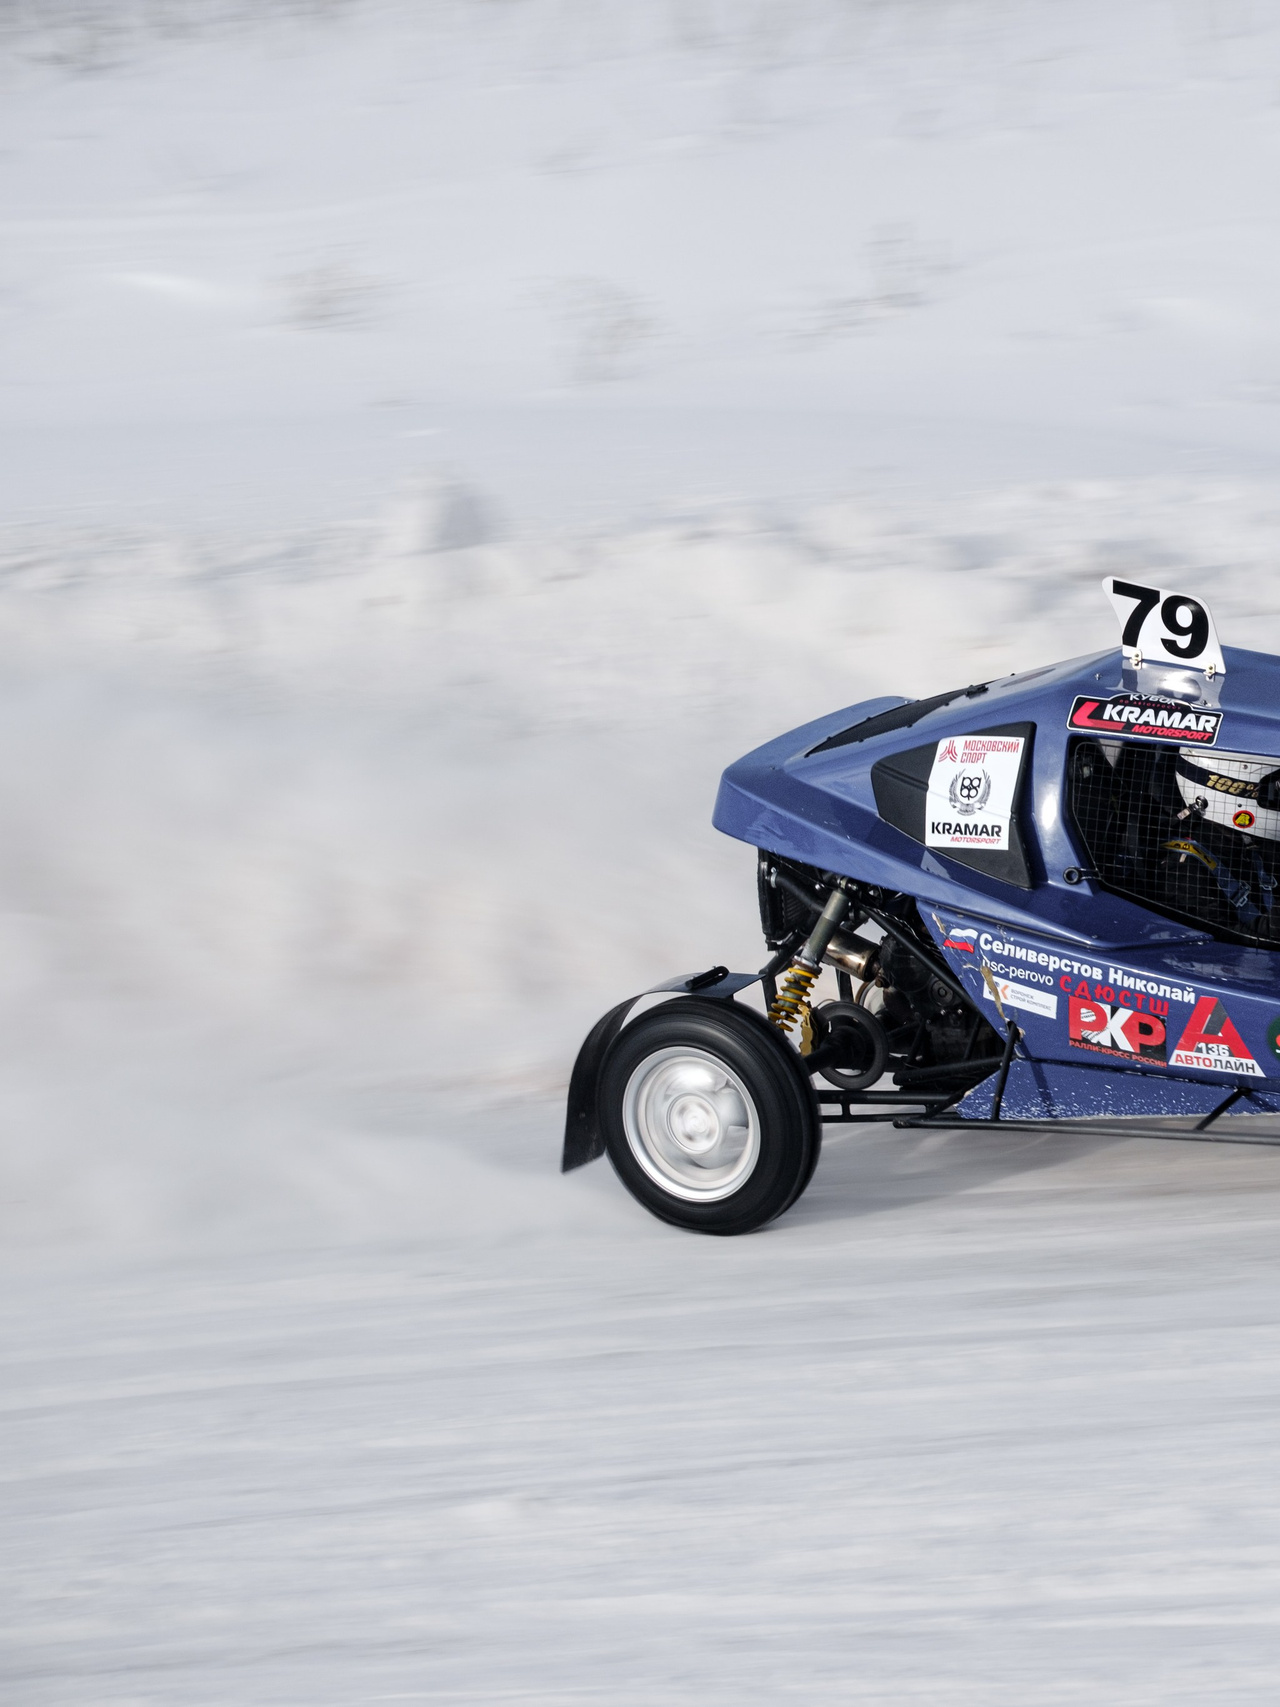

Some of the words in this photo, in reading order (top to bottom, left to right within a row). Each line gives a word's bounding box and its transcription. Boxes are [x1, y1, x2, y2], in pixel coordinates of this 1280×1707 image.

[1112, 579, 1210, 660] 79
[1102, 703, 1217, 732] KRAMAR
[1131, 725, 1213, 741] MOTORSPORT
[963, 739, 1020, 753] МОСКОВСКИЙ
[960, 752, 987, 764] СПОРТ
[931, 821, 1002, 837] KRAMAR
[950, 836, 1001, 845] MOTORSPORT
[979, 932, 1103, 980] Селиверстов
[1108, 968, 1196, 1005] Николай
[1059, 975, 1169, 1016] СДЮСТШ
[1069, 1040, 1130, 1059] РАЛЛИ-КРОСС
[1131, 1053, 1167, 1068] РОССИИ
[1197, 1042, 1230, 1057] 136
[1174, 1053, 1256, 1074] АВТОЛАЙН
